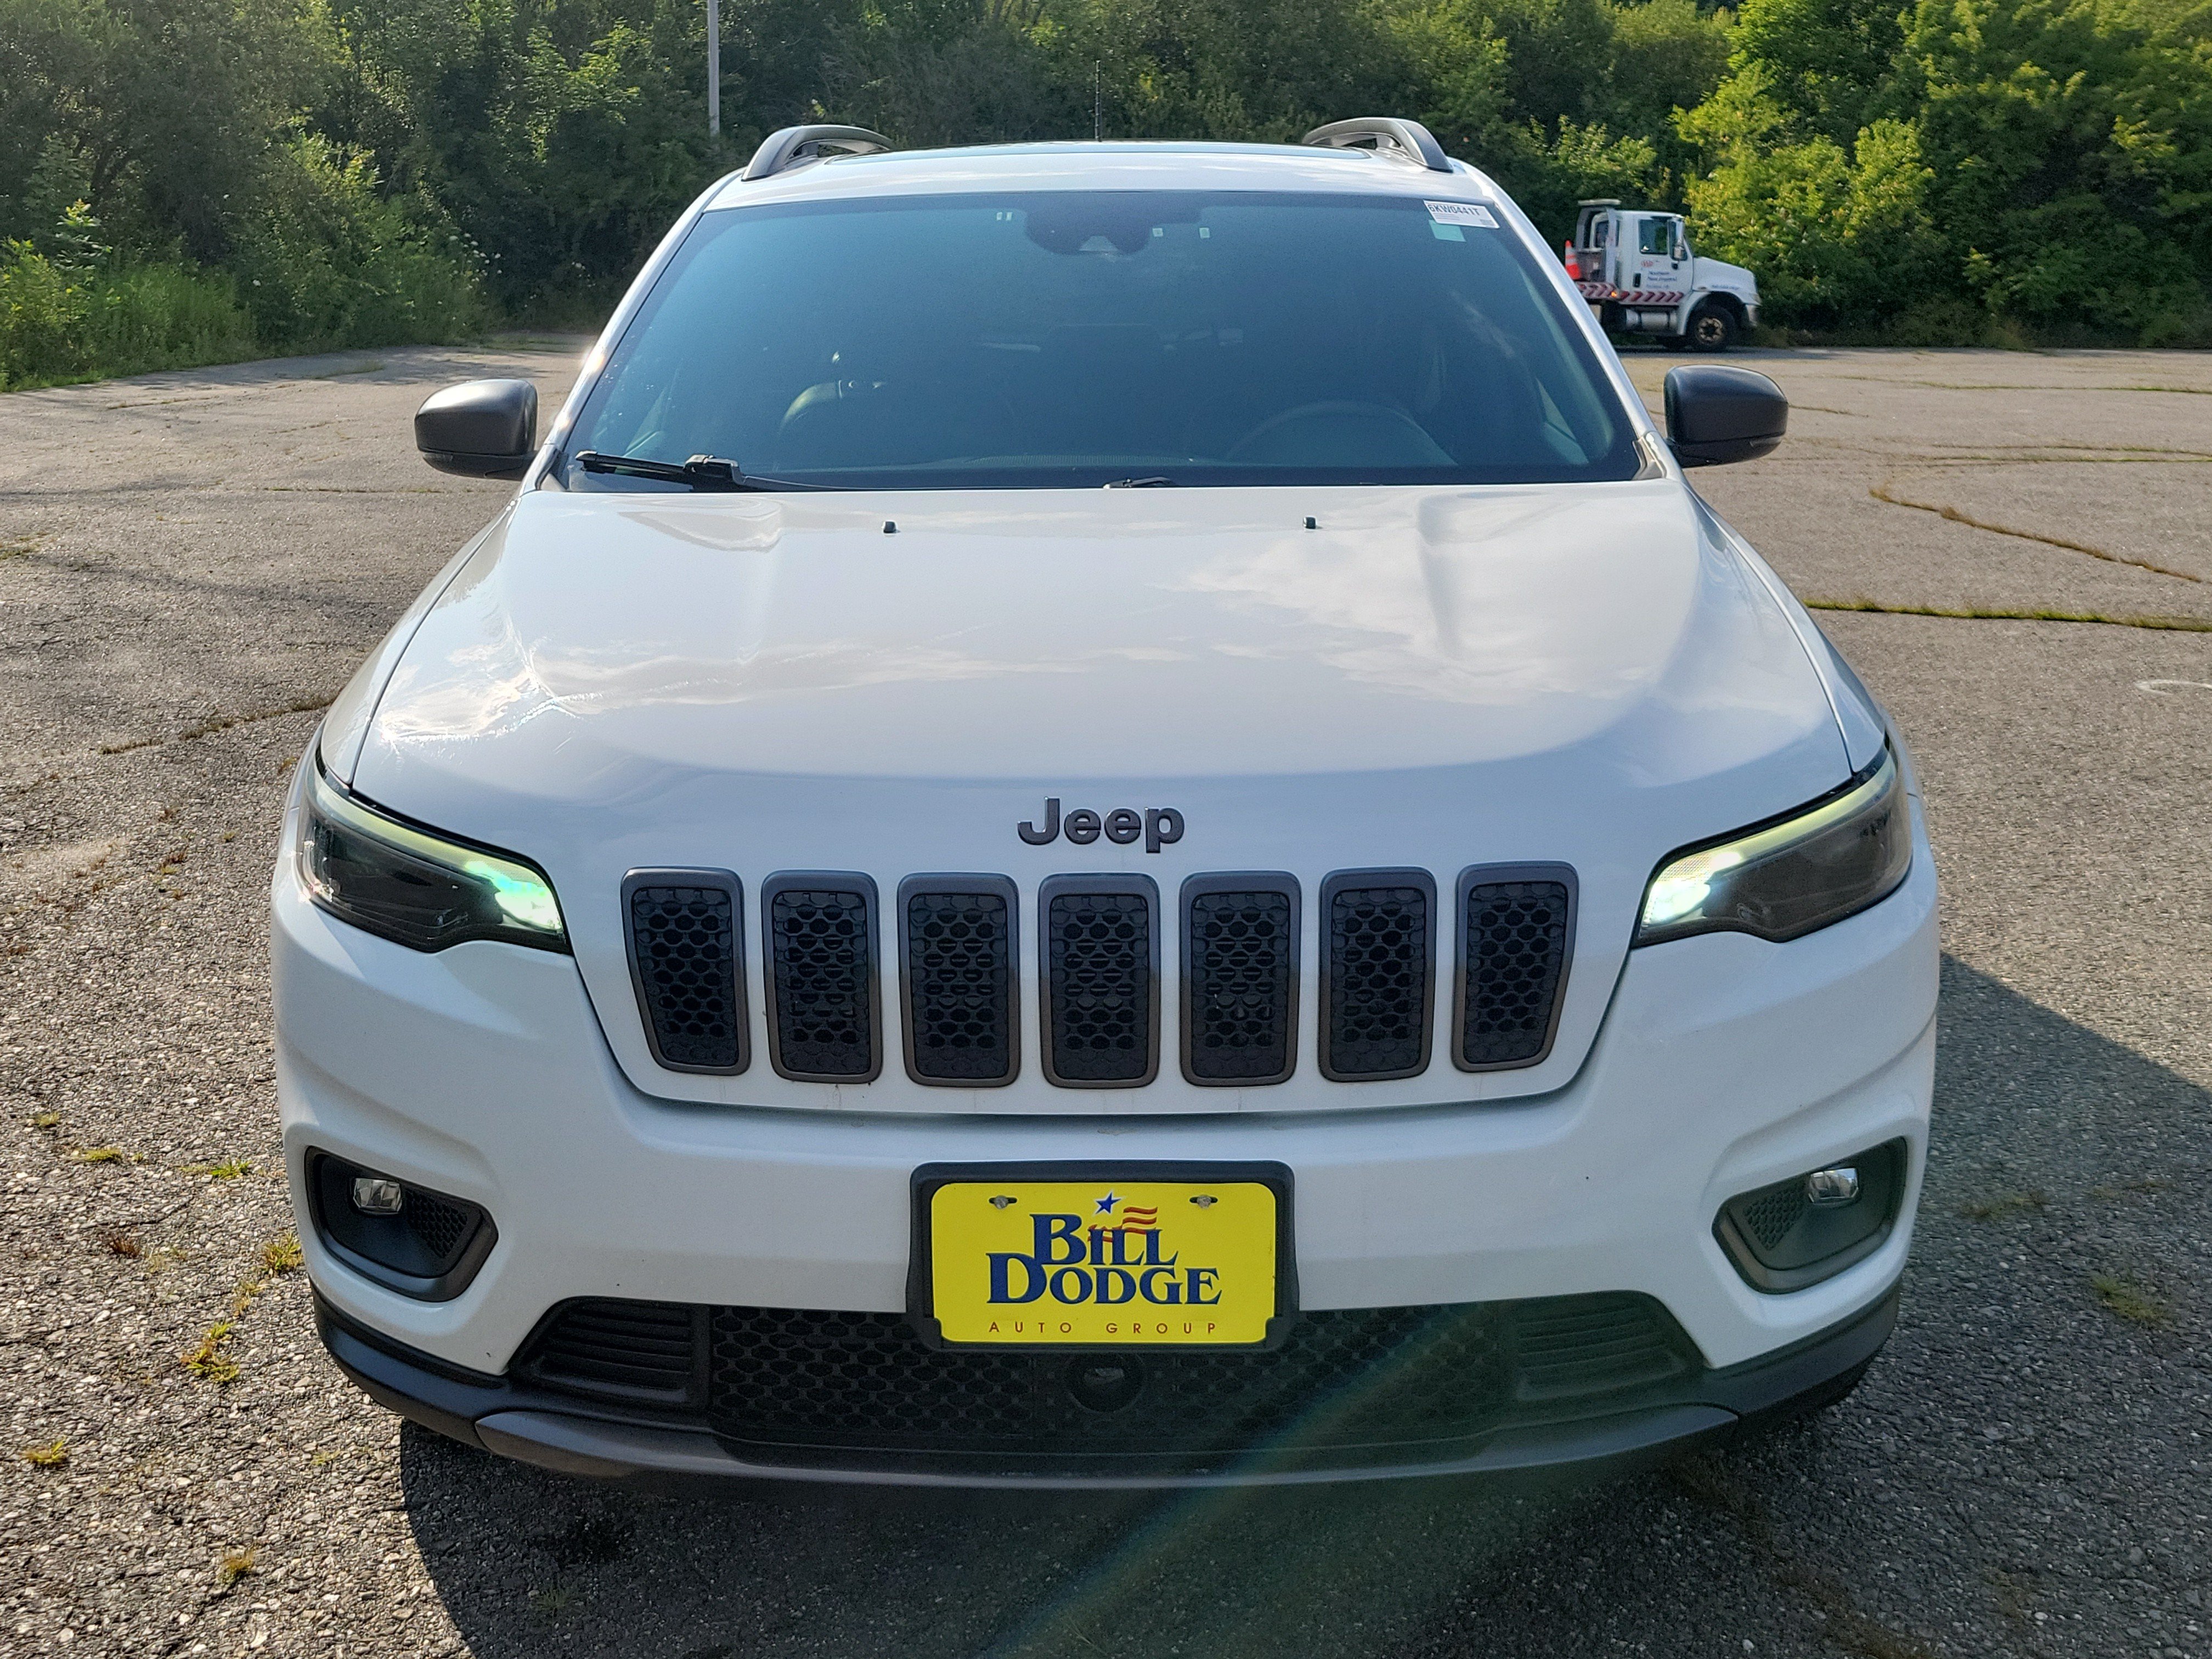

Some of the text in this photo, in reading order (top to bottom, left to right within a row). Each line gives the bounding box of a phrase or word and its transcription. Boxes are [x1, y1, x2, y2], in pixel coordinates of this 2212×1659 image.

[1017, 796, 1185, 854] Jeep
[1030, 1214, 1179, 1266] BILL
[986, 1252, 1222, 1305] DODGE
[989, 1322, 1216, 1334] AUTO GROUP
